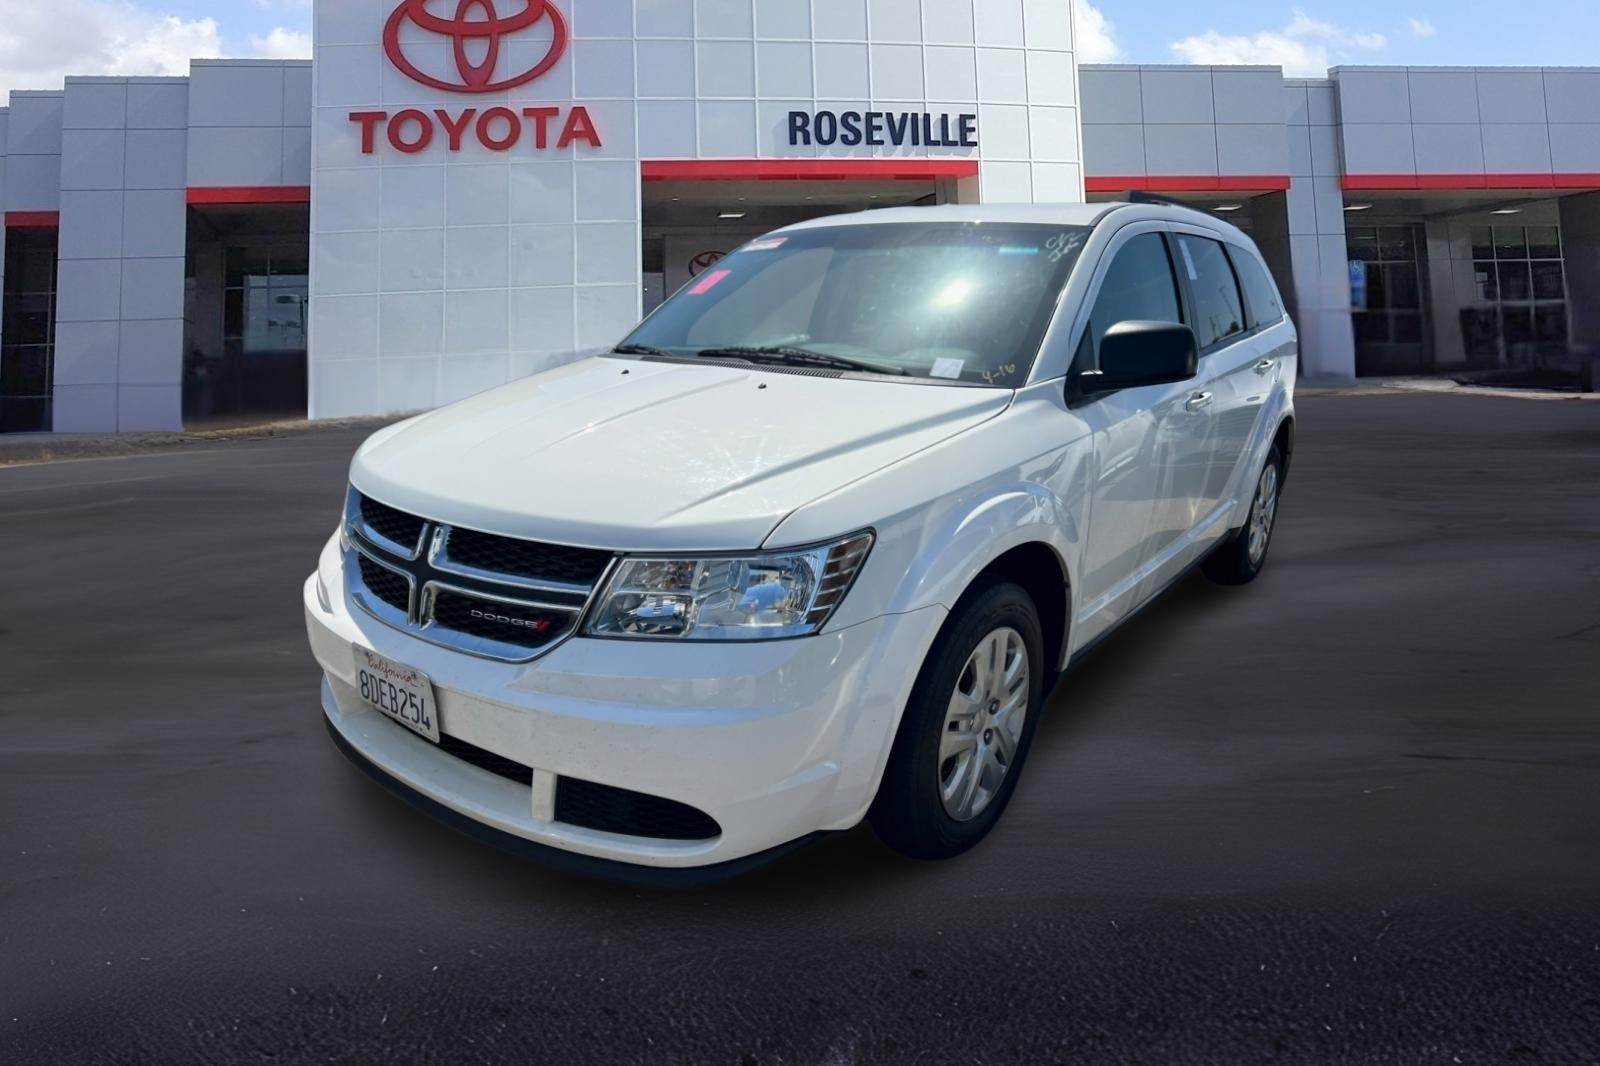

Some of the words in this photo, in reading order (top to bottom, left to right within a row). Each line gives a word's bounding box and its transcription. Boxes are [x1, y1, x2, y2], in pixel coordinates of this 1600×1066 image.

[349, 106, 602, 154] TOYOTA
[788, 111, 978, 147] ROSEVILLE
[470, 609, 539, 627] DODGE
[367, 654, 413, 683] California
[360, 669, 431, 731] 8DEB254
